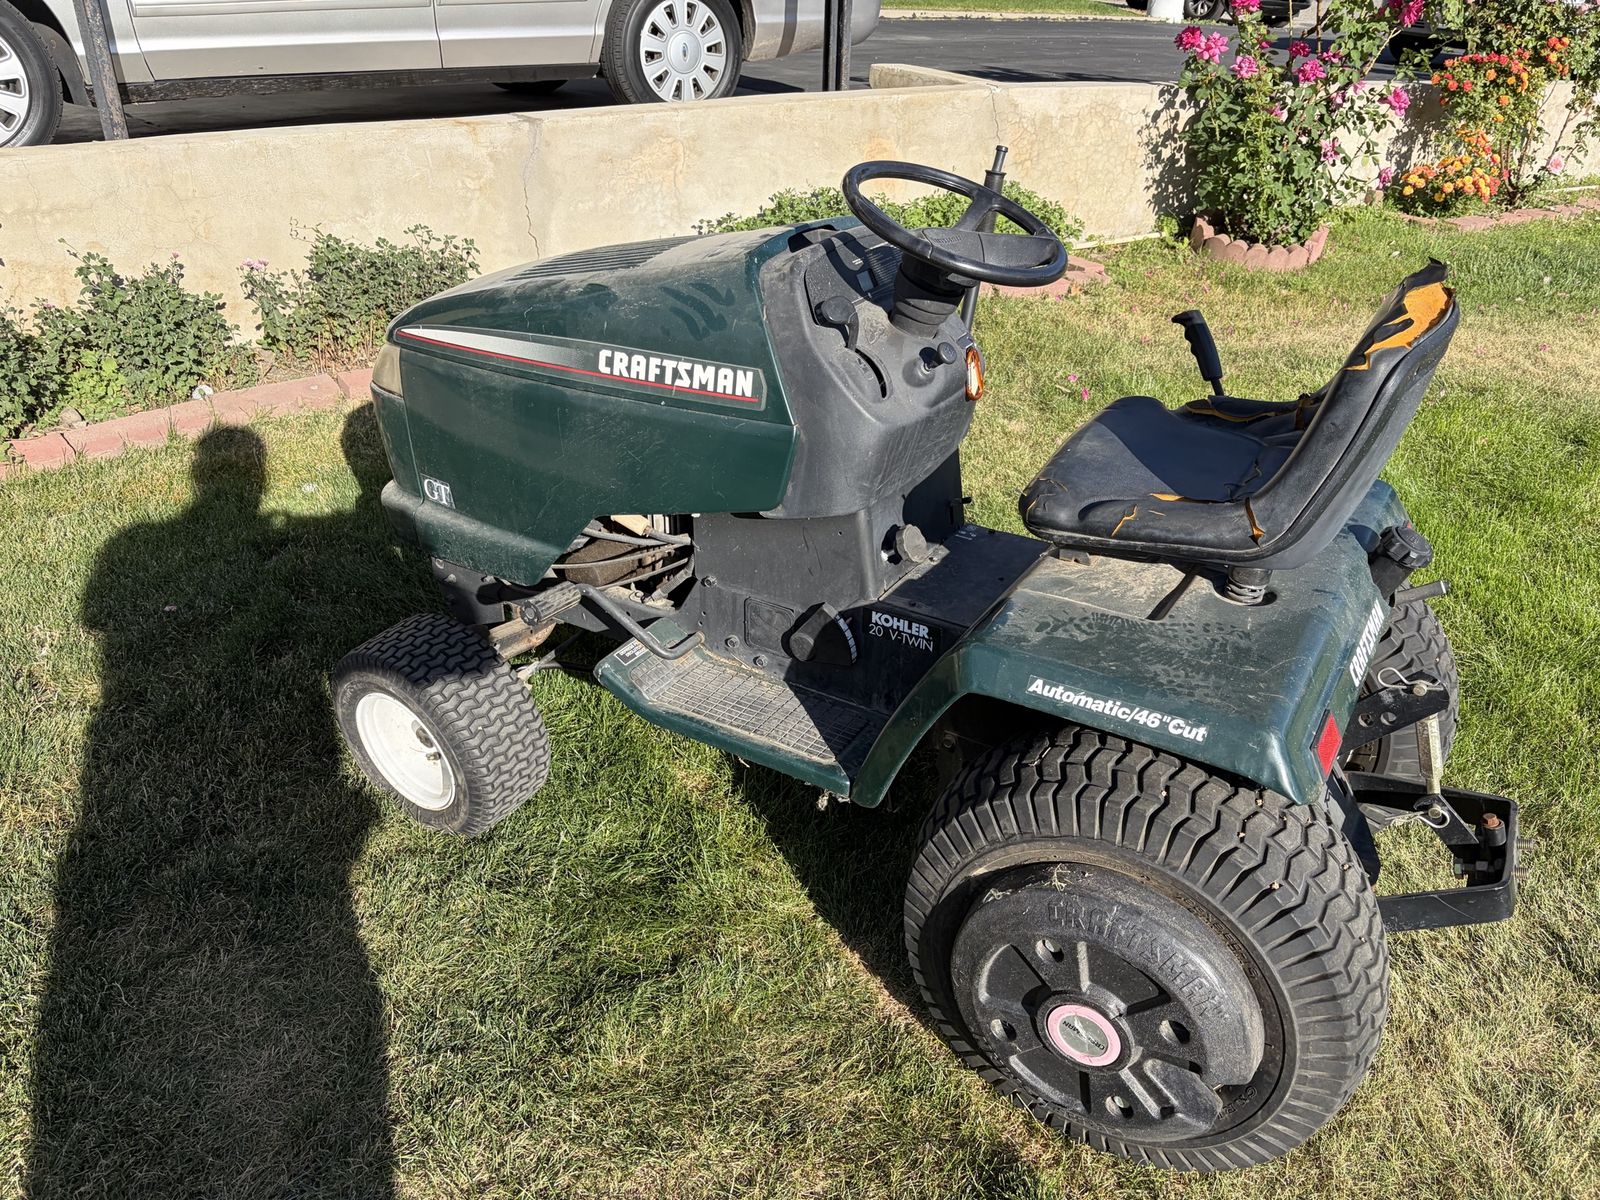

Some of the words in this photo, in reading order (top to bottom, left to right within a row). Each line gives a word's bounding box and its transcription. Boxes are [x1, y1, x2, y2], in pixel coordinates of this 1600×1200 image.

[598, 349, 754, 398] CRAFTSMAN
[423, 479, 450, 505] GT
[868, 624, 884, 637] 20
[889, 629, 934, 652] V-TWIN
[871, 610, 929, 639] KOHLER
[1349, 597, 1385, 687] CRAFTSMAN
